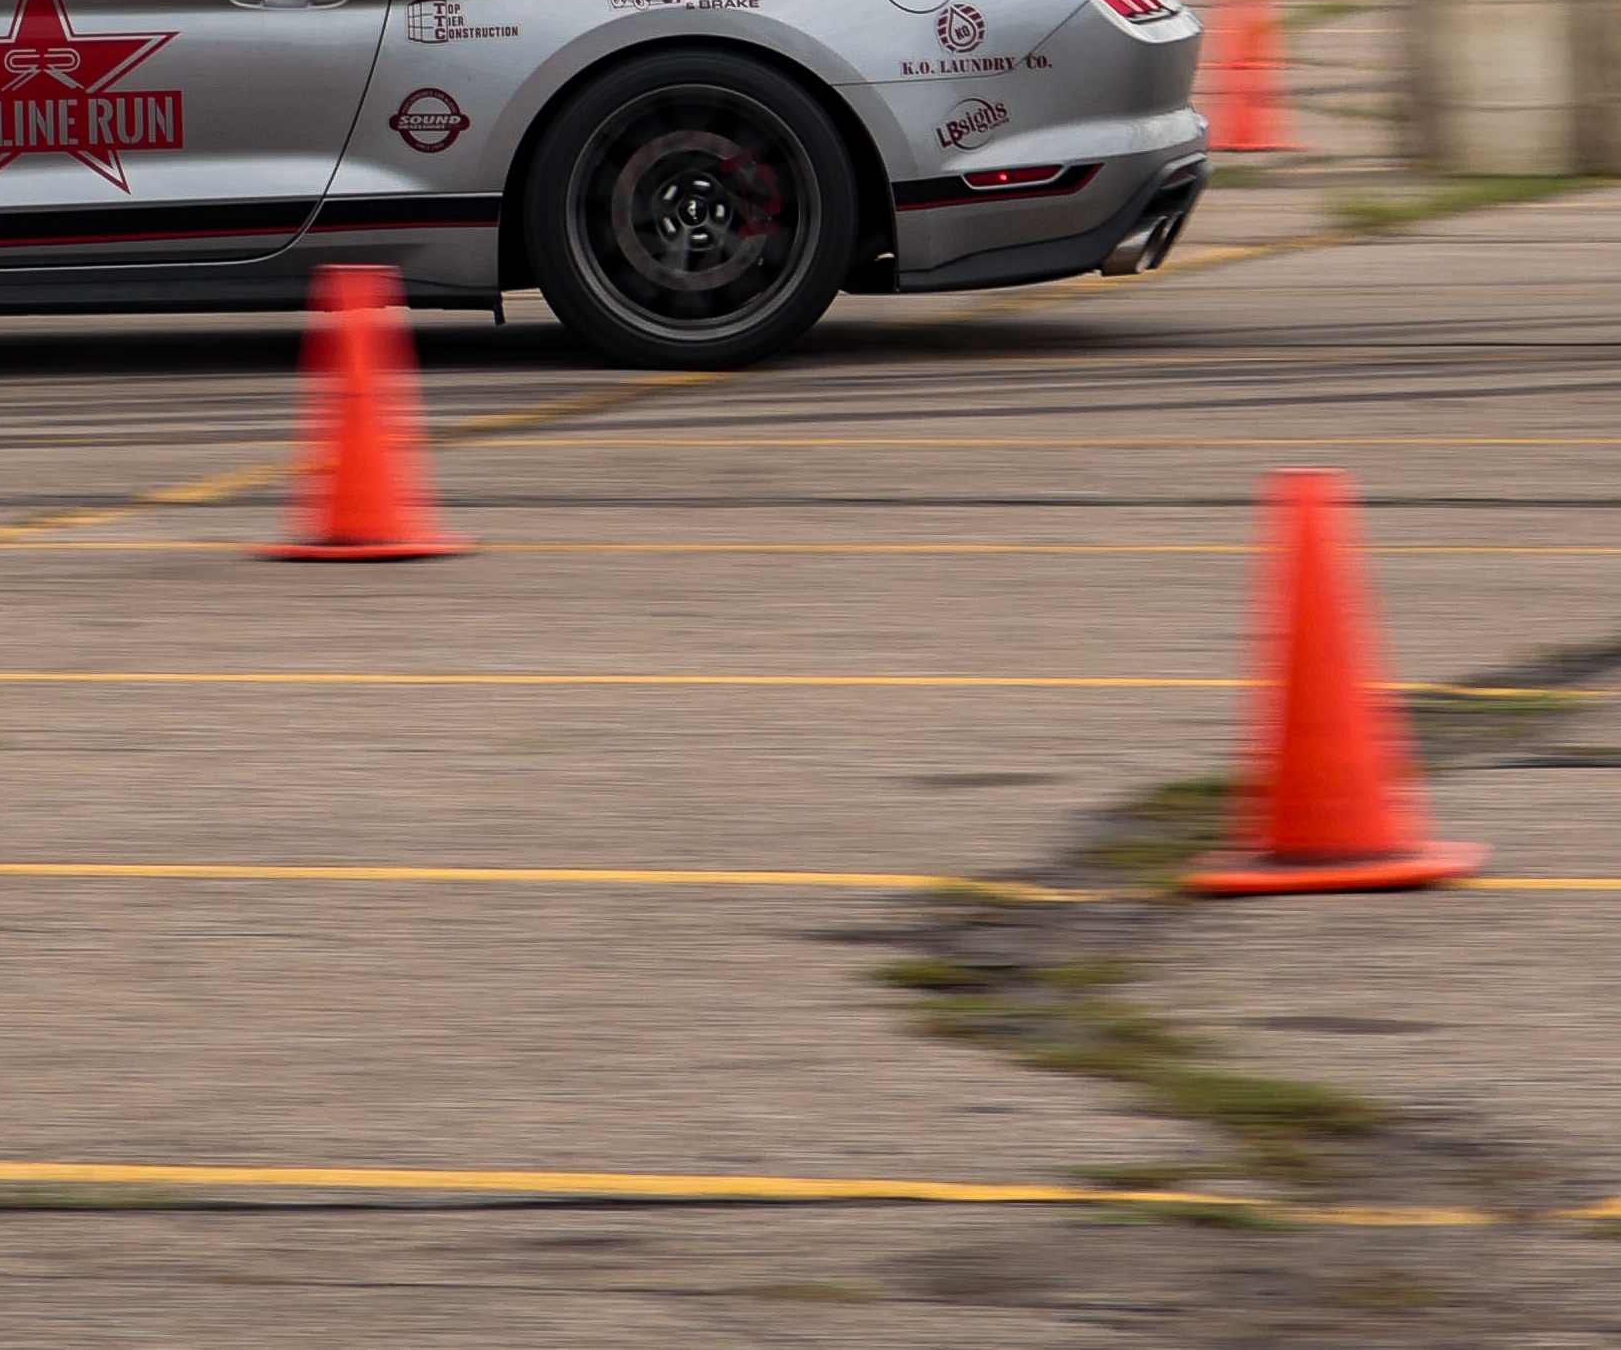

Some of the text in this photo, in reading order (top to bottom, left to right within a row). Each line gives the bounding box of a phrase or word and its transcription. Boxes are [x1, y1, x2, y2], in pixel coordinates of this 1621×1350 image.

[433, 3, 461, 14] TOP
[686, 1, 696, 11] &
[433, 15, 464, 27] TIER
[435, 26, 519, 40] CONSTRUCTION
[902, 54, 1053, 76] K.O. LAUNDRY CO.
[88, 97, 174, 145] RUN
[399, 116, 461, 124] SOUND
